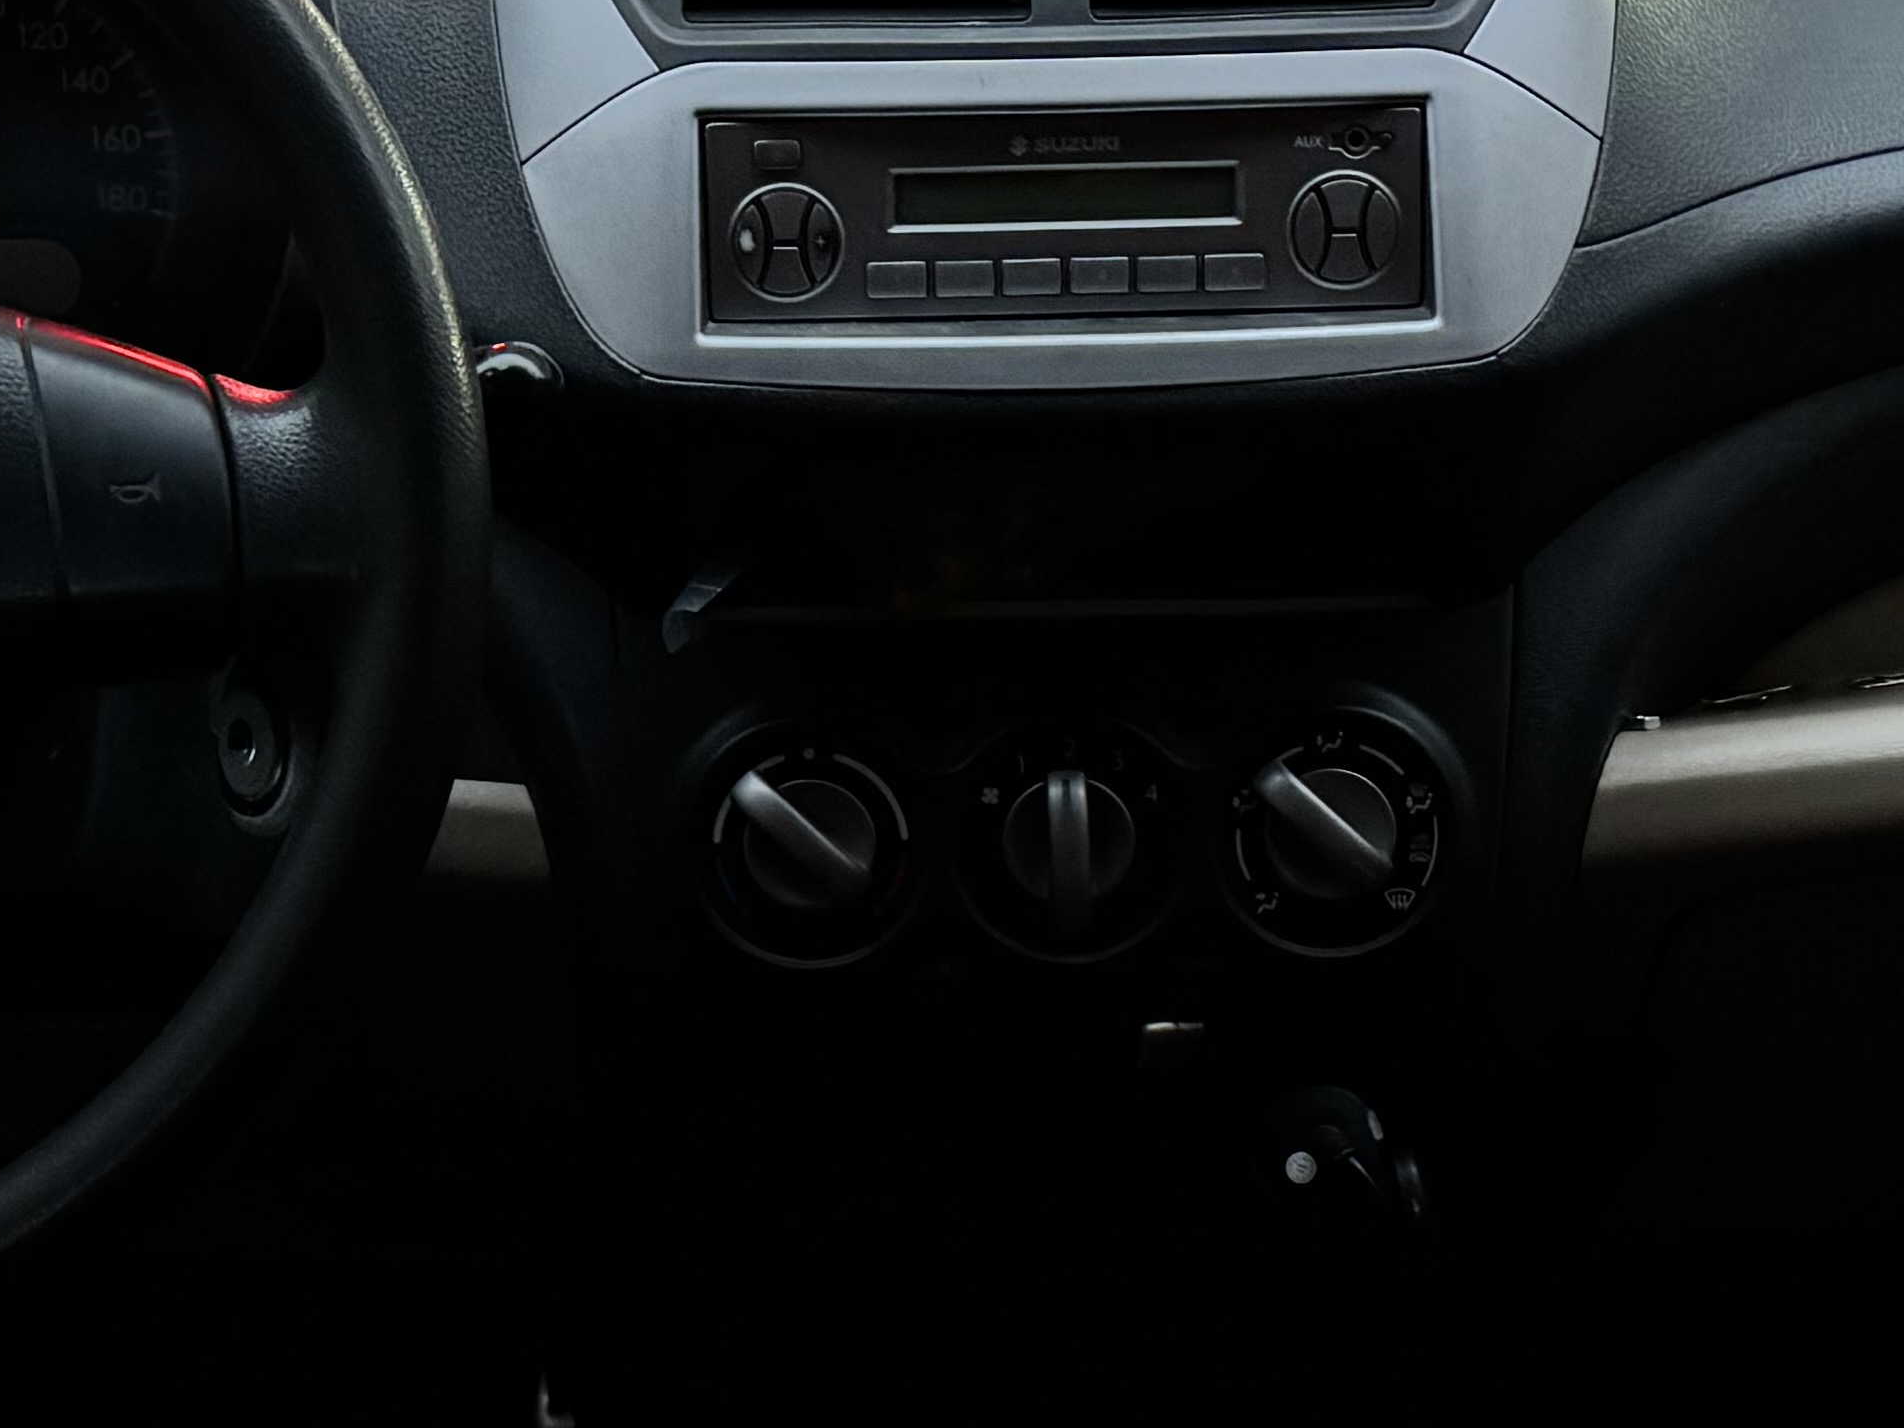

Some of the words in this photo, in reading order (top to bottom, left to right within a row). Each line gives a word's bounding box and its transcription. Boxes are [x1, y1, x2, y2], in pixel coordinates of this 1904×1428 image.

[17, 21, 70, 51] 120
[60, 65, 112, 95] 140
[91, 124, 142, 153] 160
[1033, 135, 1121, 154] SUZUKI
[1293, 134, 1325, 149] AUX
[97, 183, 149, 212] 180
